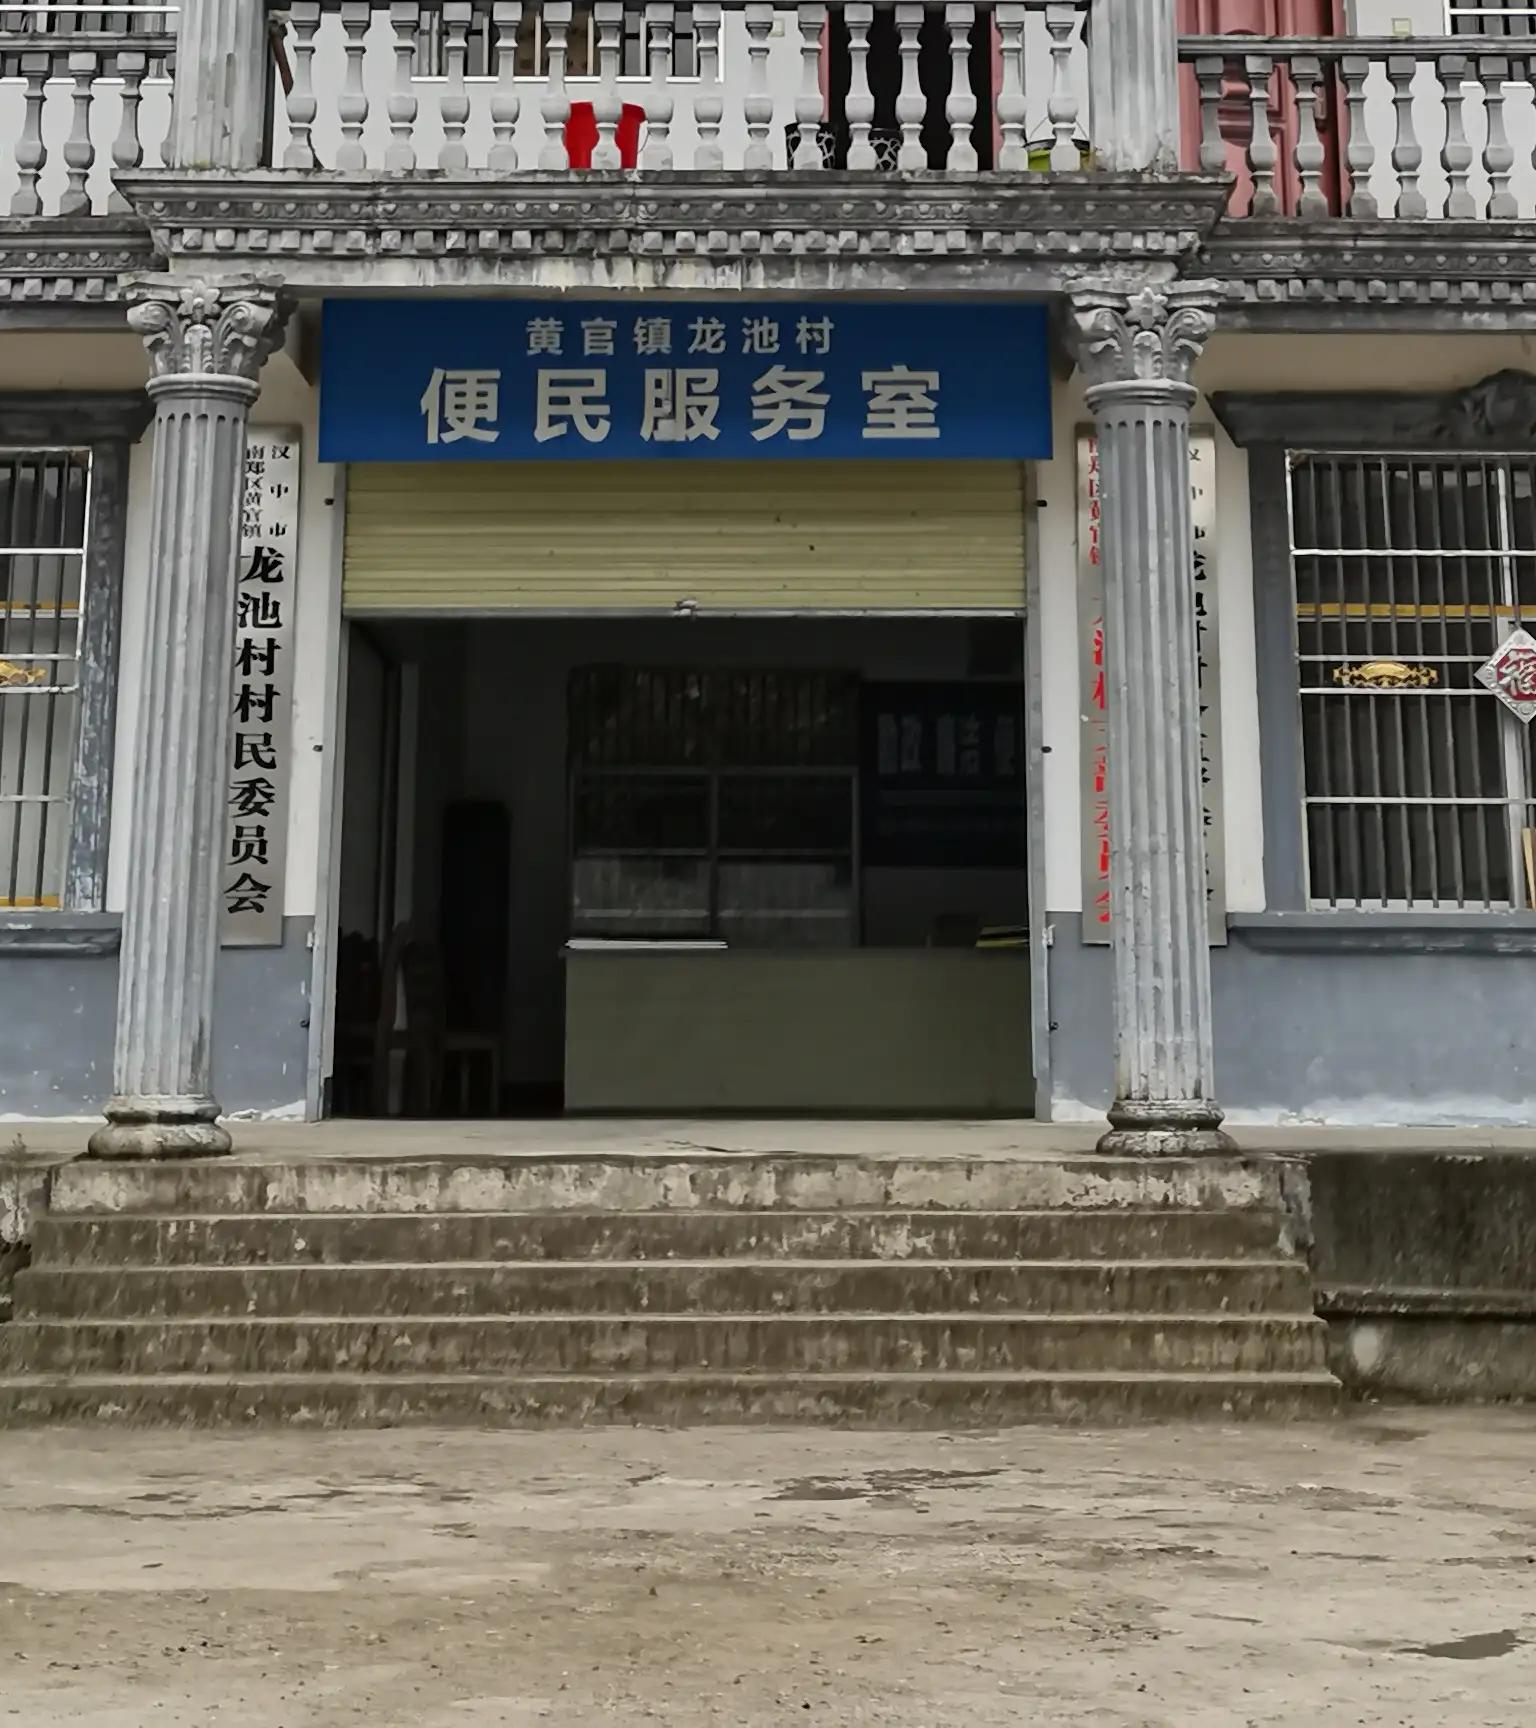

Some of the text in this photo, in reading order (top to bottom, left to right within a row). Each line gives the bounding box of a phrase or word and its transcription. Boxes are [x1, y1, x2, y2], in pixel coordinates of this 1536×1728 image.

[524, 316, 836, 358] 黄官镇龙池村
[419, 364, 942, 445] 便民服务室
[223, 545, 285, 915] 龙池村村民委员会
